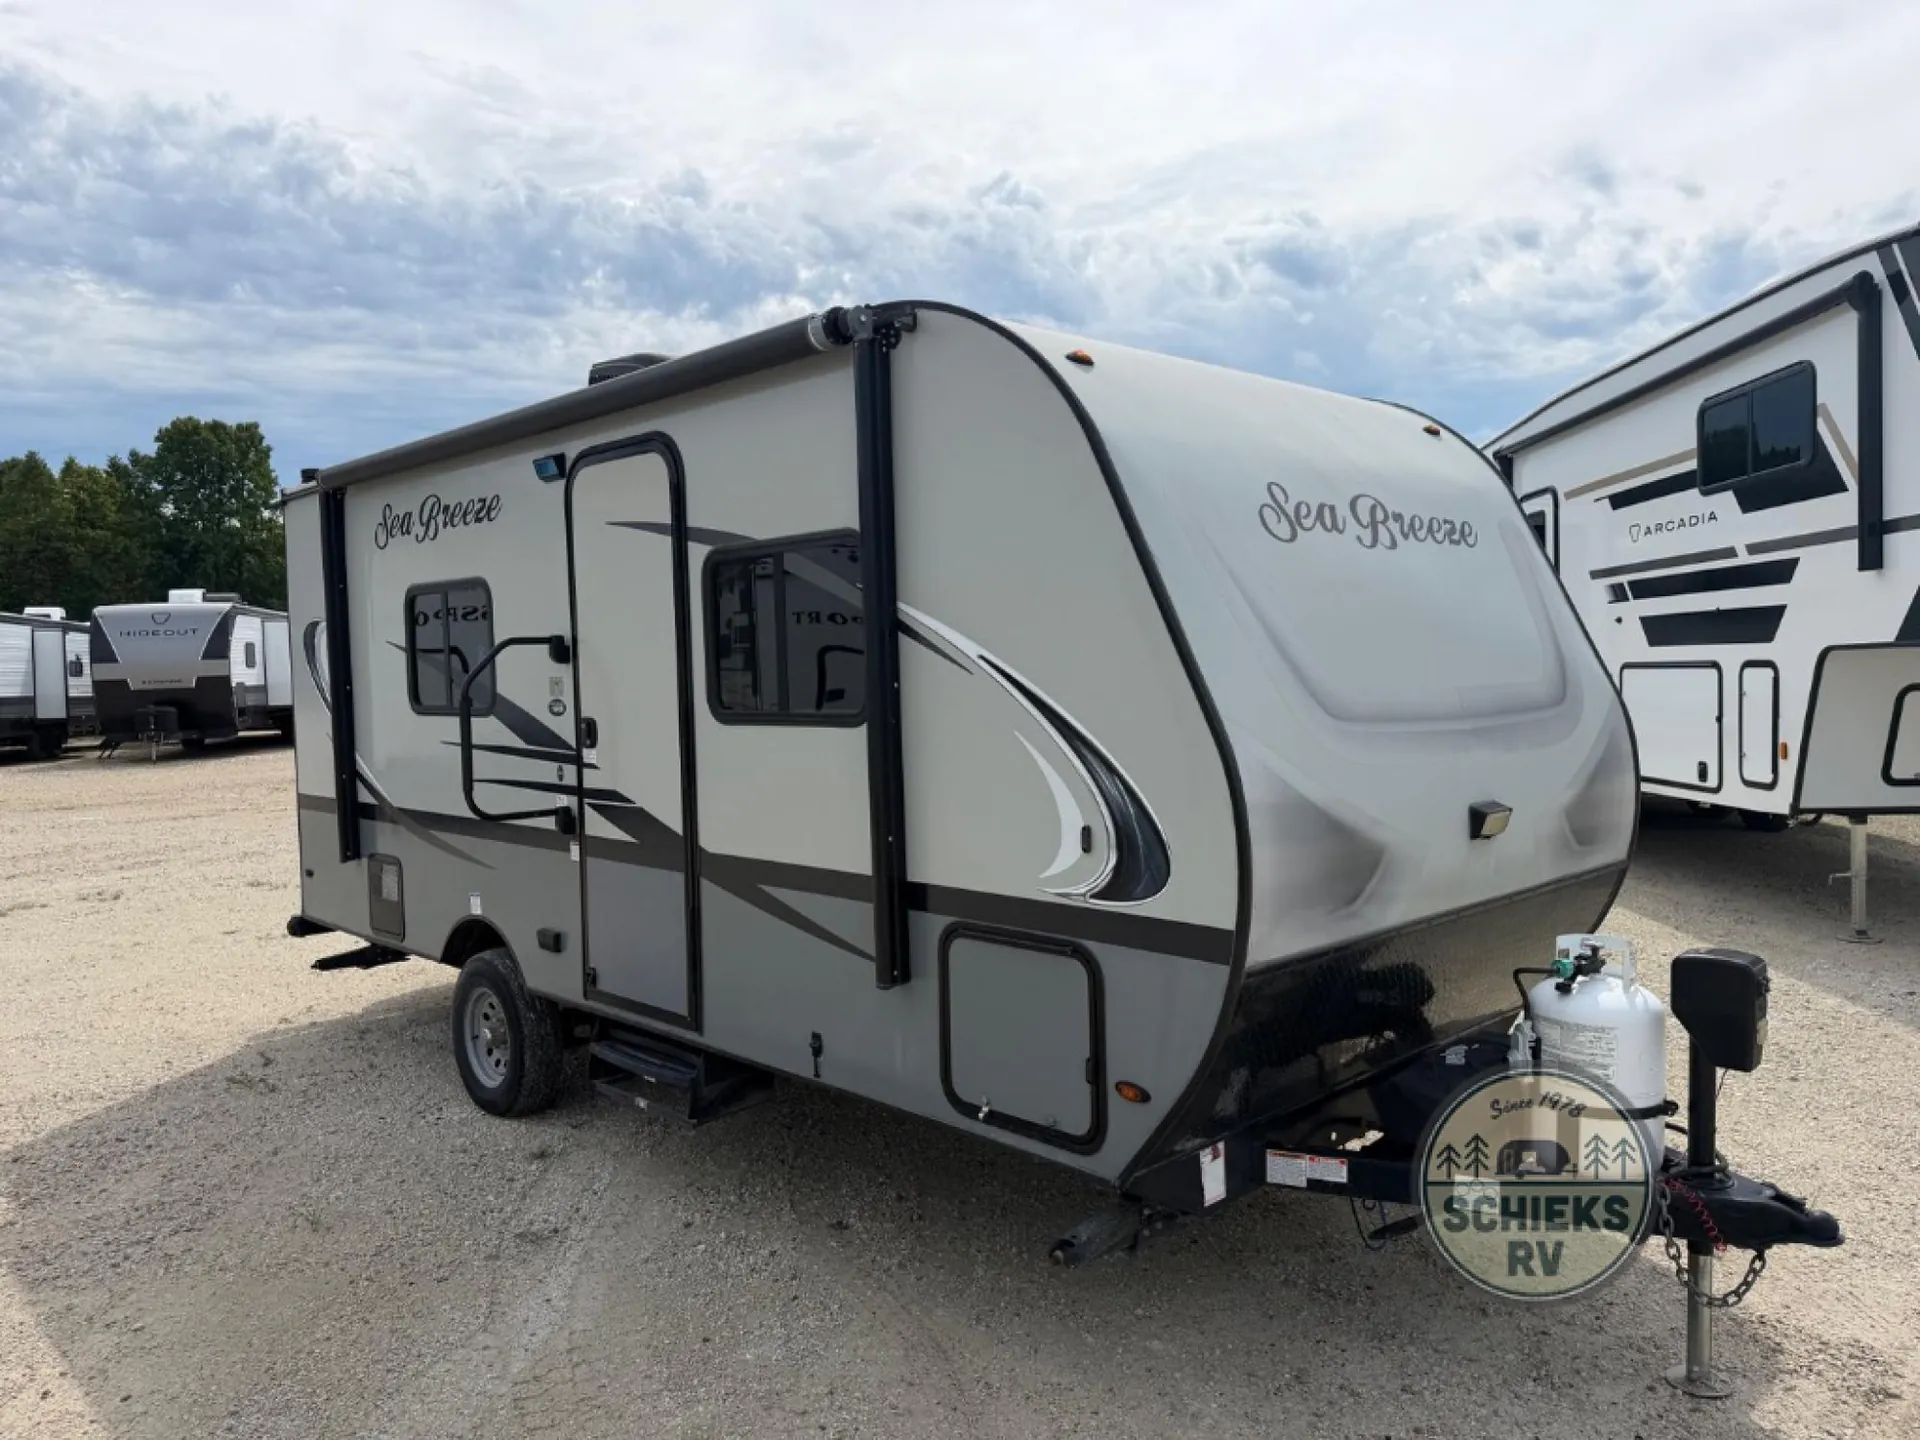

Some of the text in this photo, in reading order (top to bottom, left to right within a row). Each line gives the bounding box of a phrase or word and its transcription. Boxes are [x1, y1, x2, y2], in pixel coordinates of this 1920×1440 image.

[374, 493, 503, 550] Sea Breeze
[1258, 481, 1478, 550] Sea Breeze
[1644, 510, 1719, 537] ARCADIA
[119, 628, 199, 637] HIDEOUT
